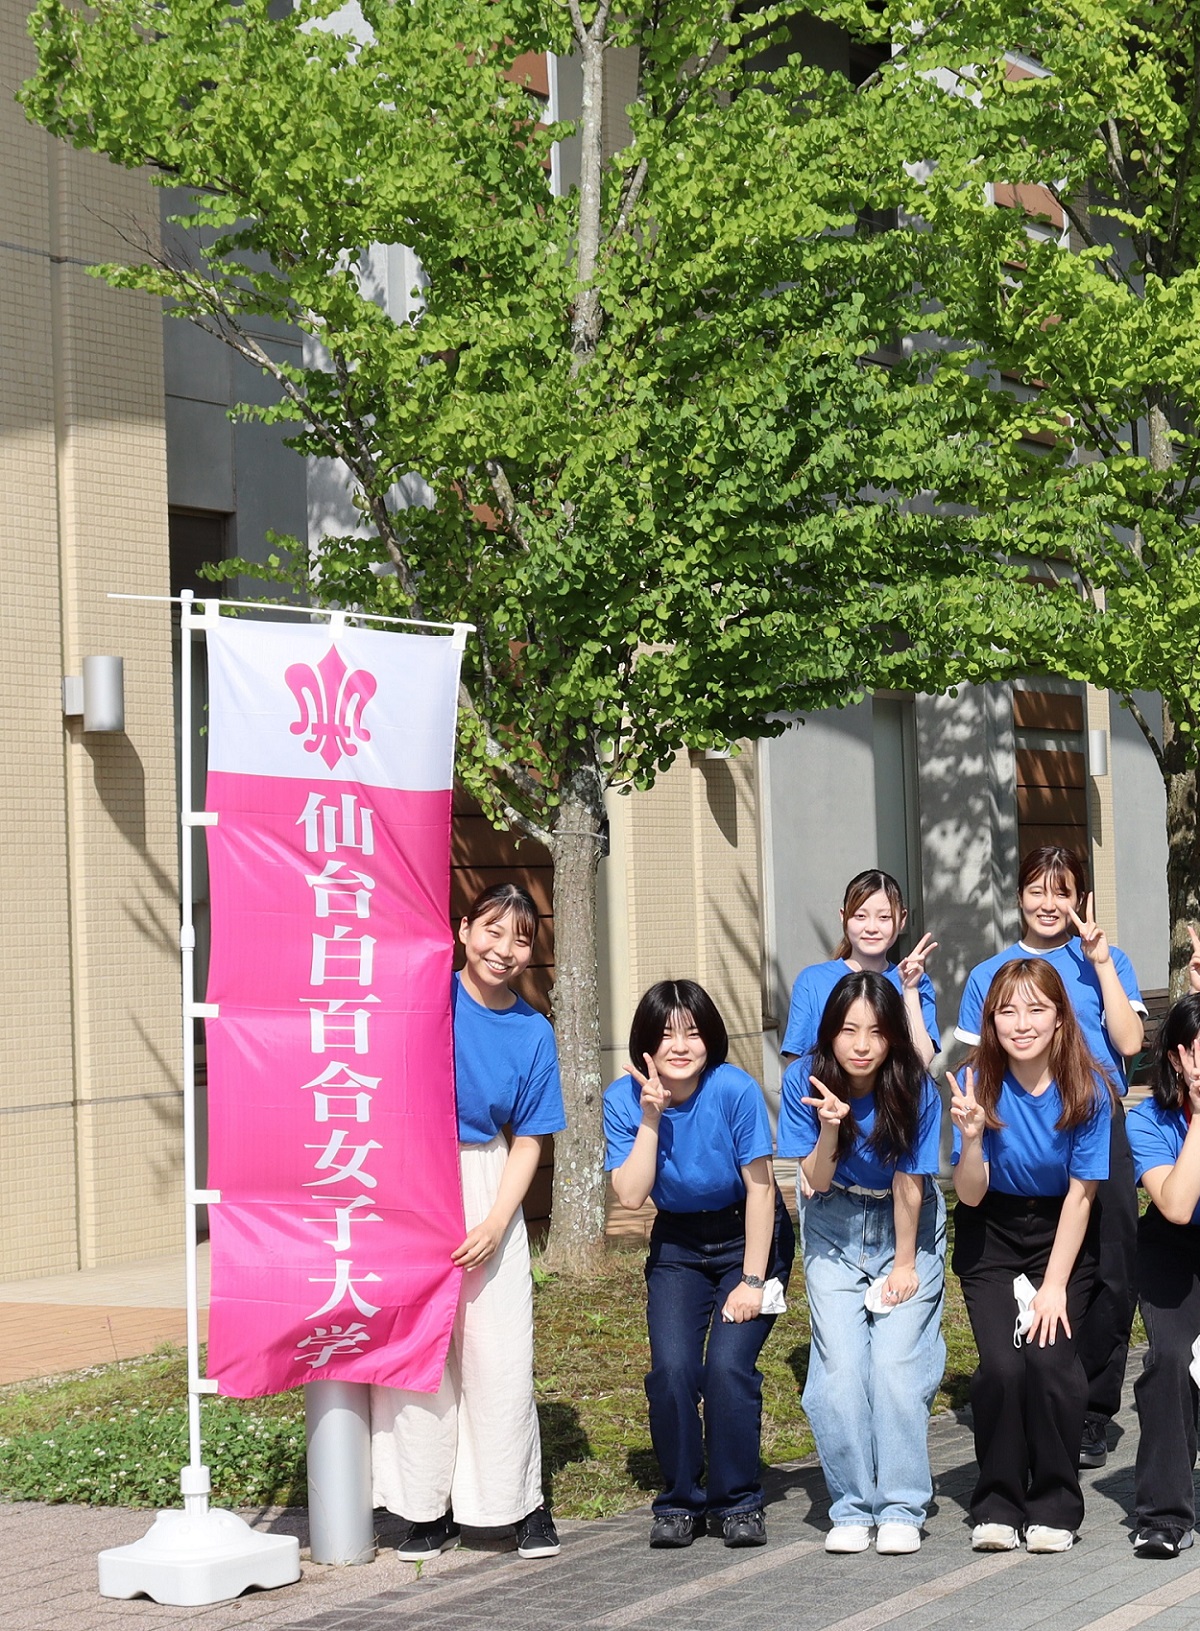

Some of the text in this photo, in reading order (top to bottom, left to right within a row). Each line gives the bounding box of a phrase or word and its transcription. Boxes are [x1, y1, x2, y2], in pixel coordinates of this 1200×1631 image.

[295, 792, 383, 1369] 仙台白百合女子大学
